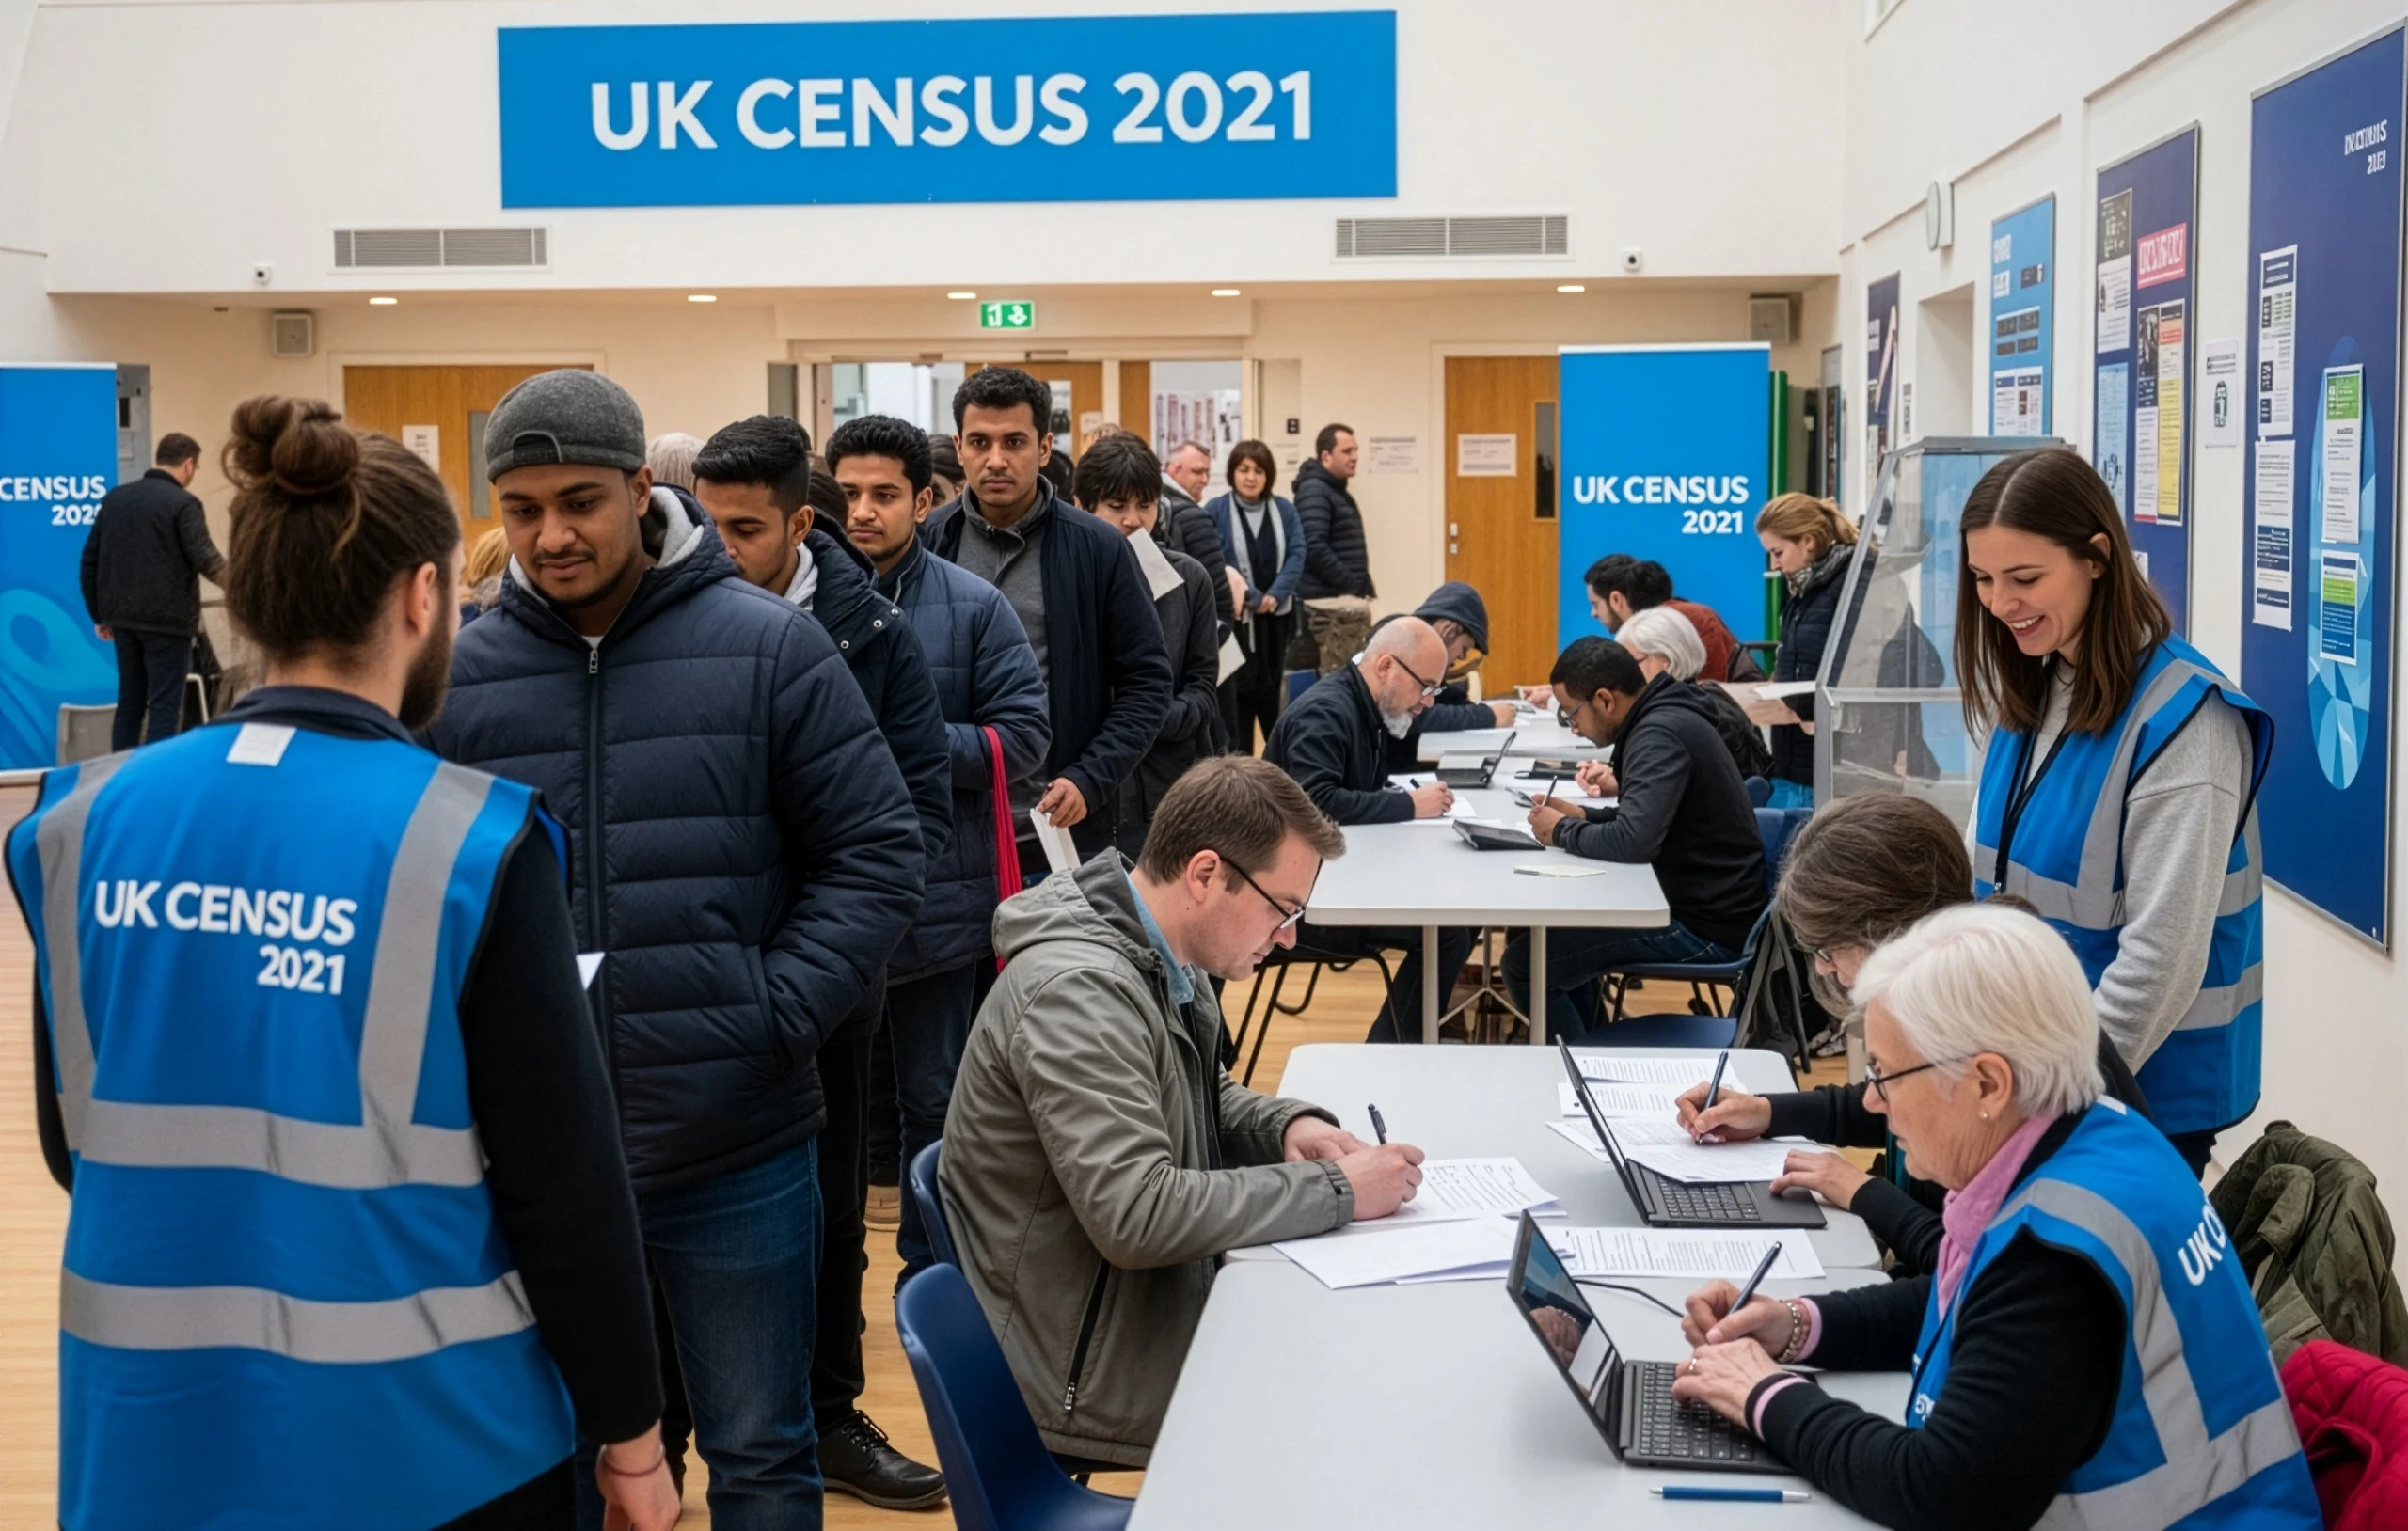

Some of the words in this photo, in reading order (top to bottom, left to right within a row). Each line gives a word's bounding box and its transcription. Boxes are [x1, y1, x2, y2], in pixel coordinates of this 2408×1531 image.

[592, 80, 718, 150] UK
[737, 74, 1089, 149] CENSUS
[1112, 71, 1311, 144] 2021
[0, 475, 107, 501] CENSUS
[1574, 476, 1620, 504] UK
[1623, 476, 1749, 504] CENSUS
[1682, 510, 1743, 534] 2021
[95, 880, 162, 928] UK
[165, 881, 358, 946] CENSUS
[257, 944, 345, 995] 2021
